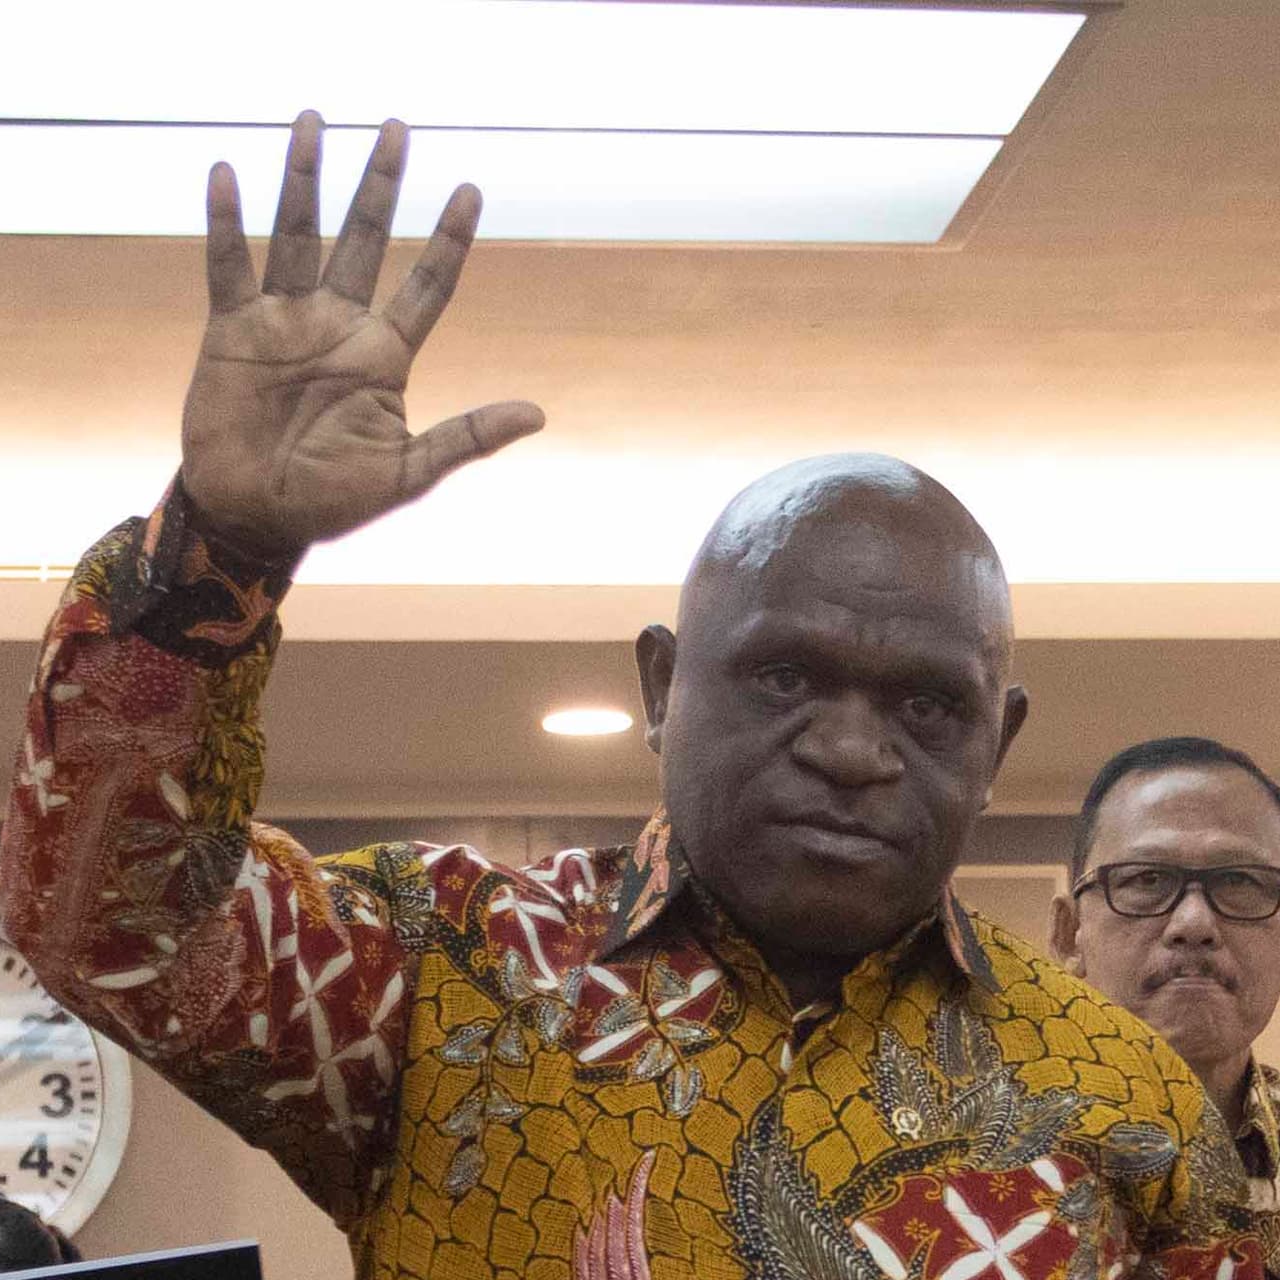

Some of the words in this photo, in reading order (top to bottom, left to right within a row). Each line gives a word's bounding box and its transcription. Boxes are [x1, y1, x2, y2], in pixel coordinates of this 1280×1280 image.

[22, 1013, 53, 1061] 2
[40, 1073, 74, 1118] 3
[19, 1132, 54, 1179] 4
